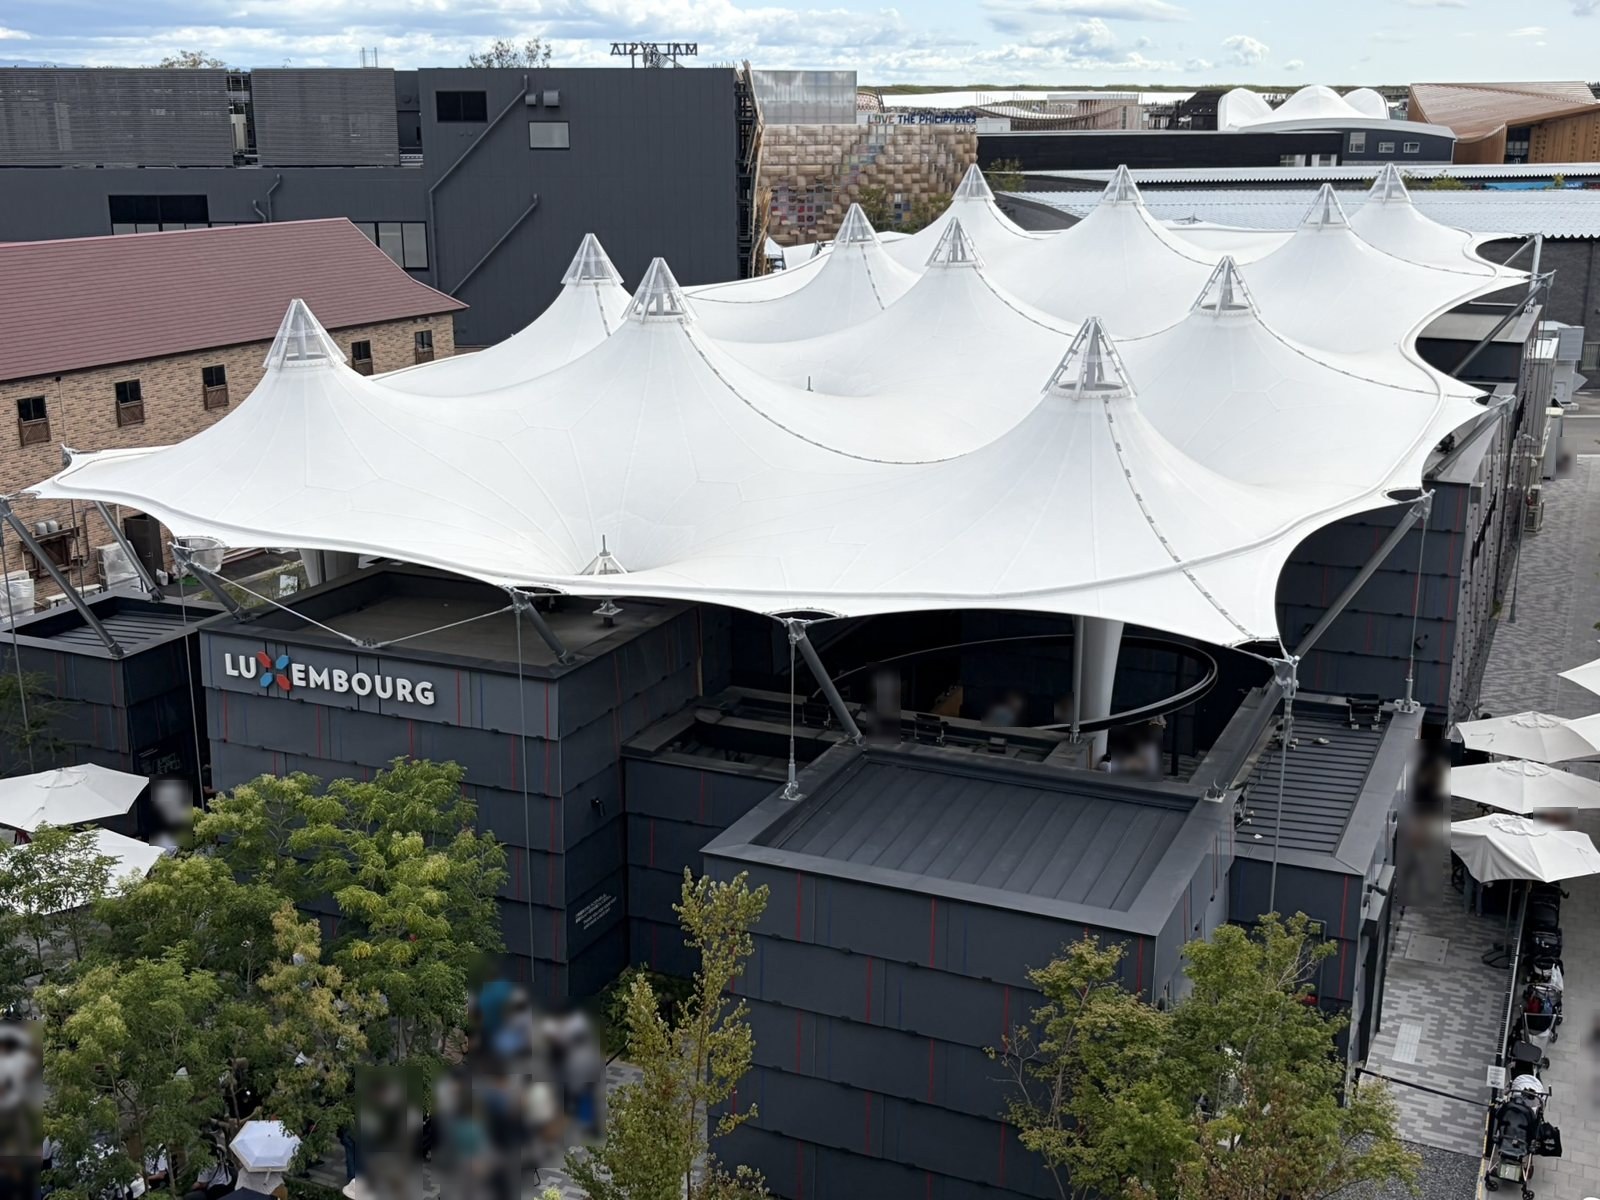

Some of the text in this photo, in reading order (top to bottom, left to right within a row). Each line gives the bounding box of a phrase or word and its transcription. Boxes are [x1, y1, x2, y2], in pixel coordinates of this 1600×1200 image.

[868, 113, 977, 124] LOVE THE PHILIPPINES
[224, 650, 436, 706] LUXEMBOURG
